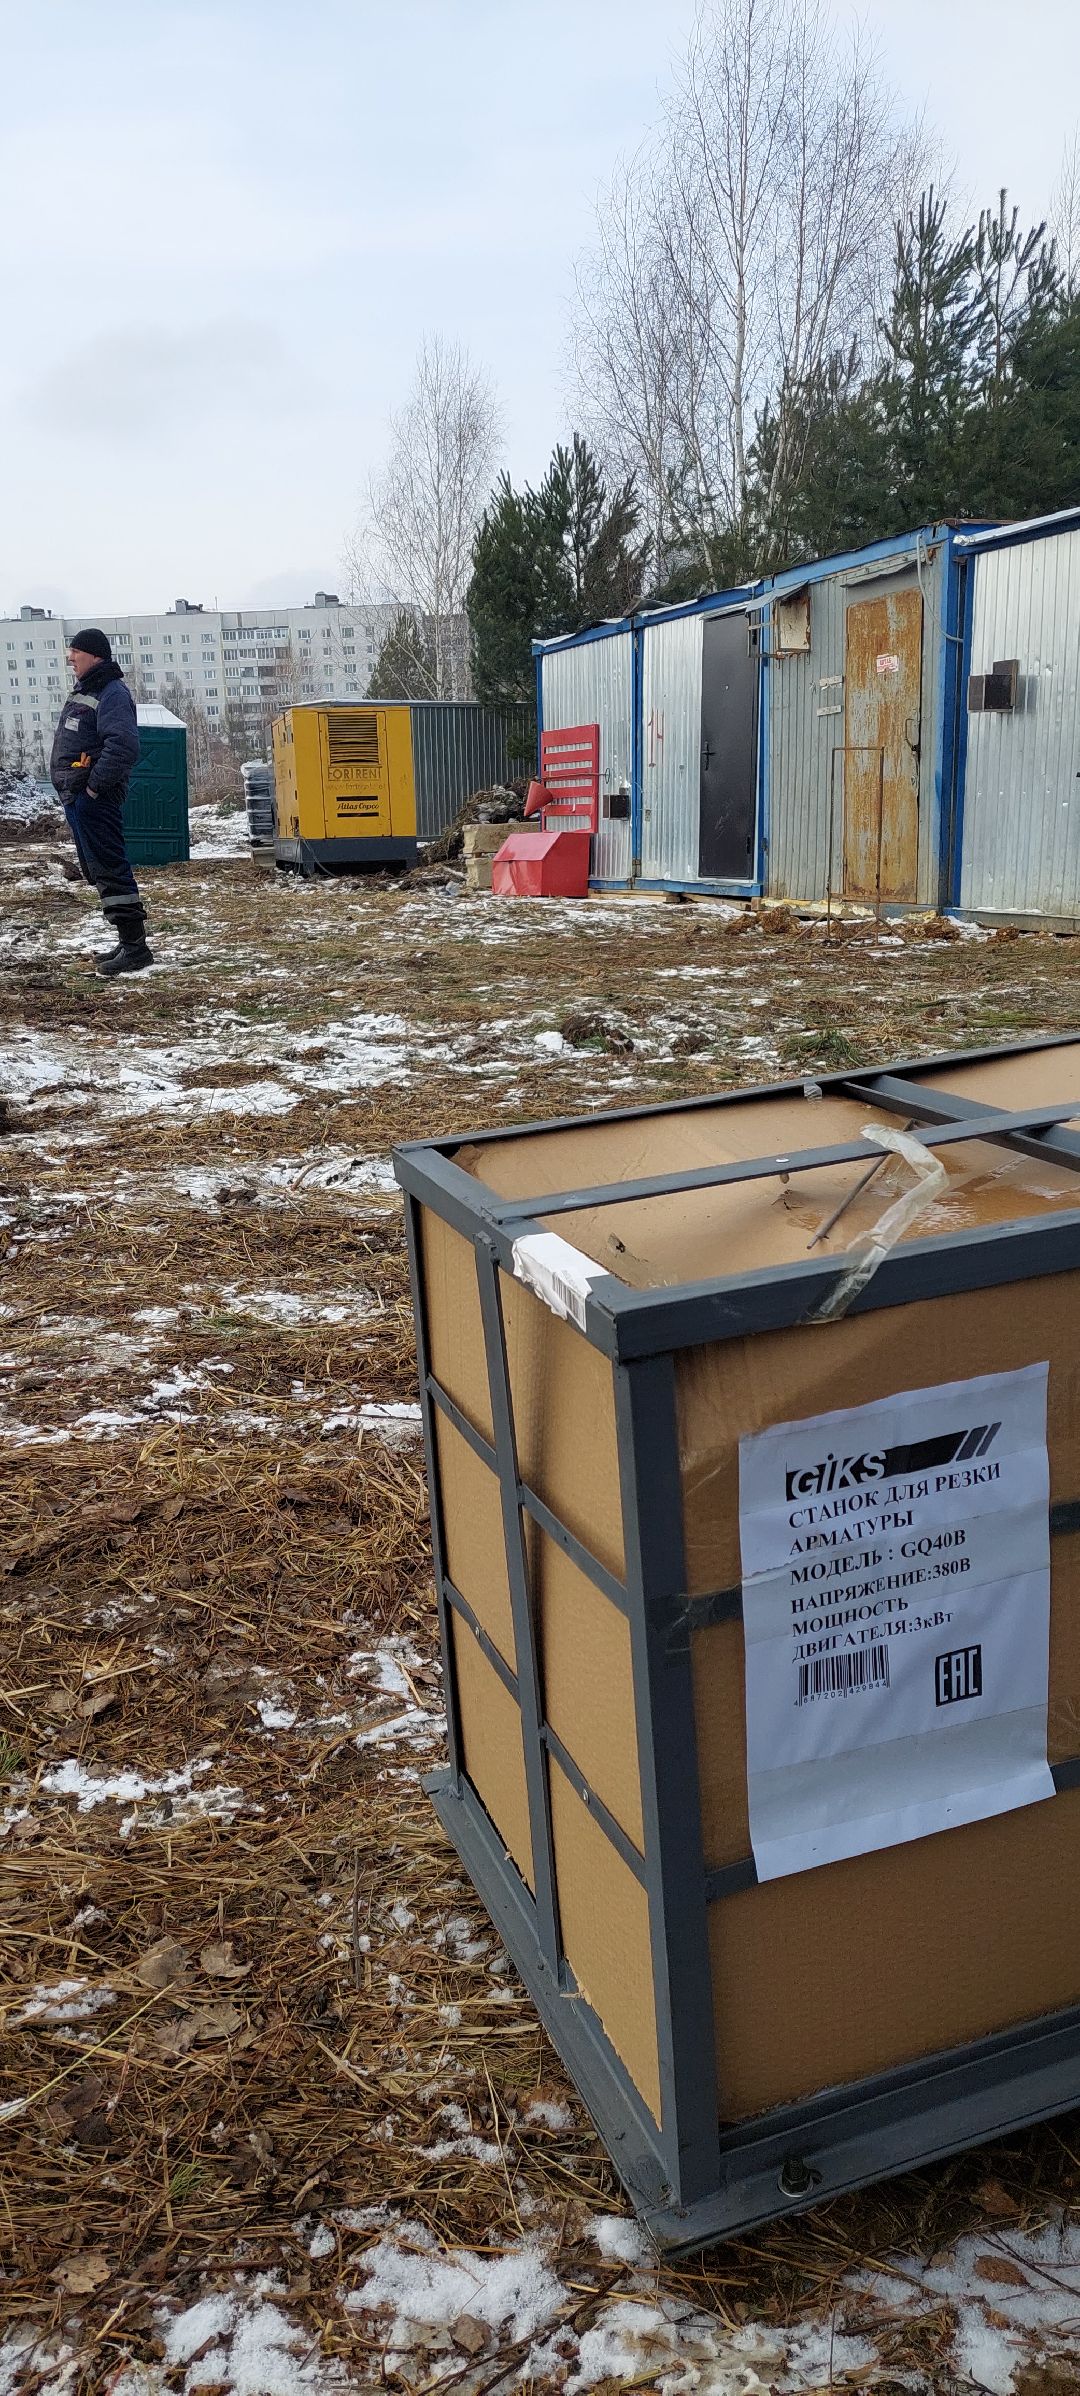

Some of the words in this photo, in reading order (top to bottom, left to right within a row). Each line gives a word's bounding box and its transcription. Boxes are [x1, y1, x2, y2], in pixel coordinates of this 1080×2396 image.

[337, 802, 358, 811] Atlas
[359, 802, 380, 811] Copco
[788, 1490, 880, 1529] СТАНОК
[884, 1479, 929, 1506] ДЛЯ
[935, 1462, 1001, 1493] РЕЗКИ
[789, 1510, 915, 1556] АРМАТУРЫ
[790, 1549, 883, 1586] МОДЕЛЬ
[901, 1529, 966, 1559] GQ40B
[791, 1557, 971, 1614] НАПРЯЖЕНИЕ:380В
[791, 1610, 954, 1664] ДВИГАТЕЛЯ:3кВт
[792, 1597, 909, 1638] МОЩНОСТЬ
